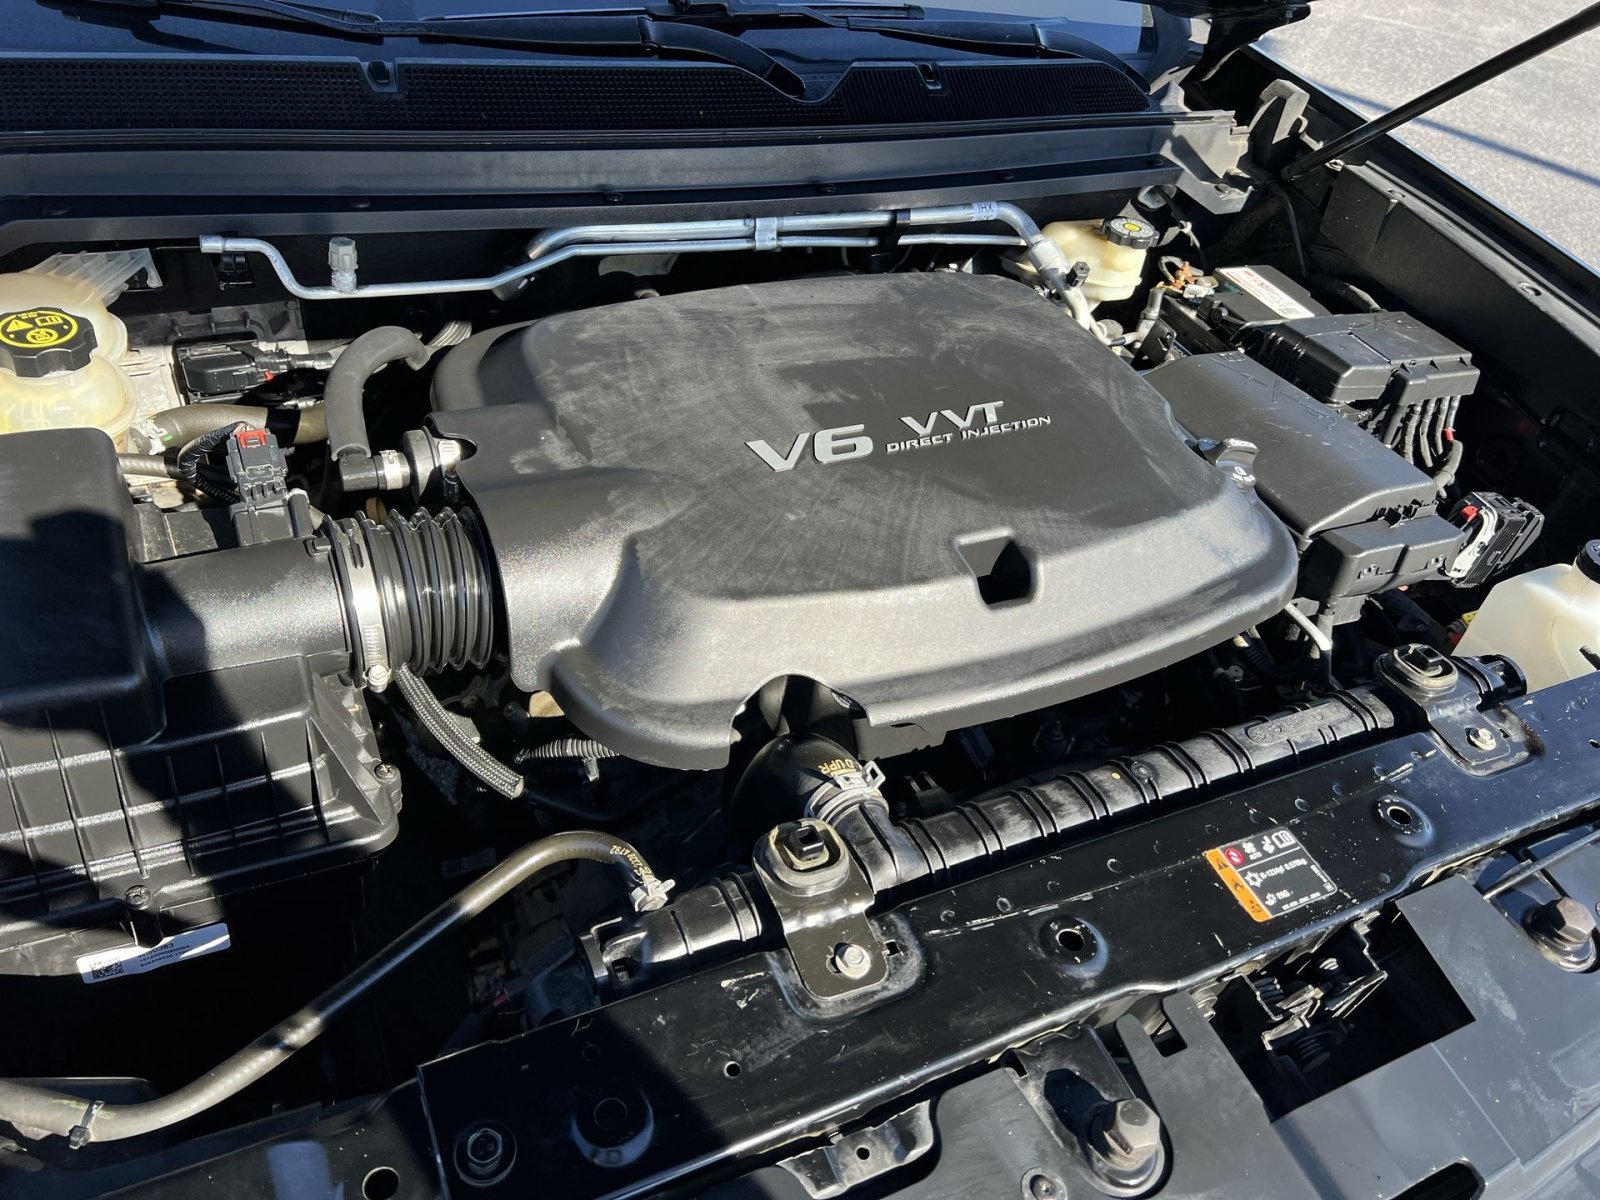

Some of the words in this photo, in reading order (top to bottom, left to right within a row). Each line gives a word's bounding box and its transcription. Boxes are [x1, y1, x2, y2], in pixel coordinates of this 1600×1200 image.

[885, 432, 953, 454] DIRECT
[961, 415, 1051, 440] INJECTION
[899, 400, 1004, 437] VVT
[743, 423, 874, 473] V6
